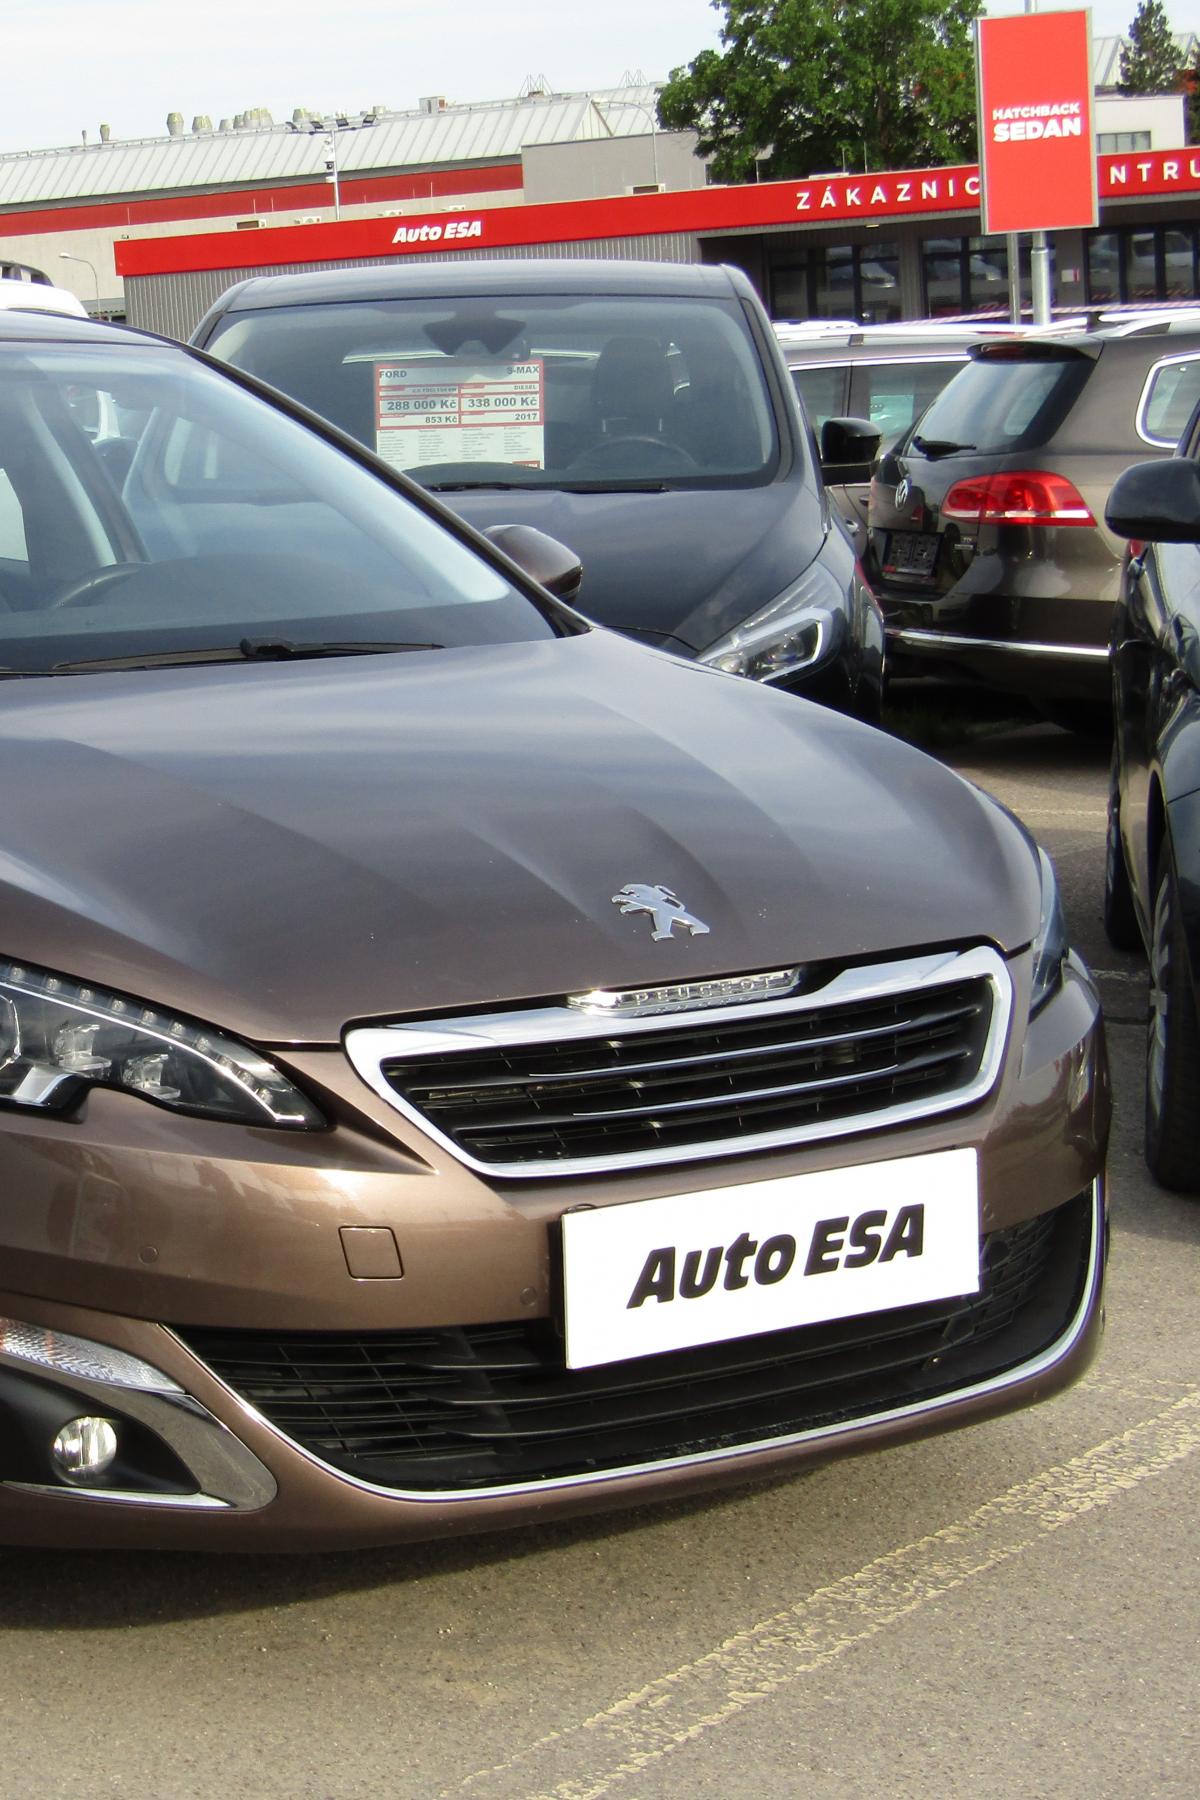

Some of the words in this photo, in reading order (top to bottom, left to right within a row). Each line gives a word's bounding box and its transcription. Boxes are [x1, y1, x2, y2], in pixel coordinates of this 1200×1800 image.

[992, 102, 1080, 120] HATCHBACK
[993, 117, 1081, 142] SEDAN
[796, 177, 979, 210] ZÁKAZNIC
[392, 225, 442, 243] Auto
[444, 221, 481, 239] ESA
[379, 370, 407, 378] FORD
[506, 366, 540, 375] S-MAX
[388, 401, 410, 411] 288
[414, 400, 437, 410] 000
[440, 399, 457, 409] Kč
[468, 398, 490, 408] 338
[494, 397, 517, 407] 000
[520, 396, 537, 406] Kč
[425, 416, 442, 424] 853
[445, 415, 458, 423] Kč
[515, 413, 538, 421] 2017
[635, 976, 774, 1006] PEUGEOT
[626, 1232, 797, 1309] Auto
[804, 1203, 925, 1276] ESA
